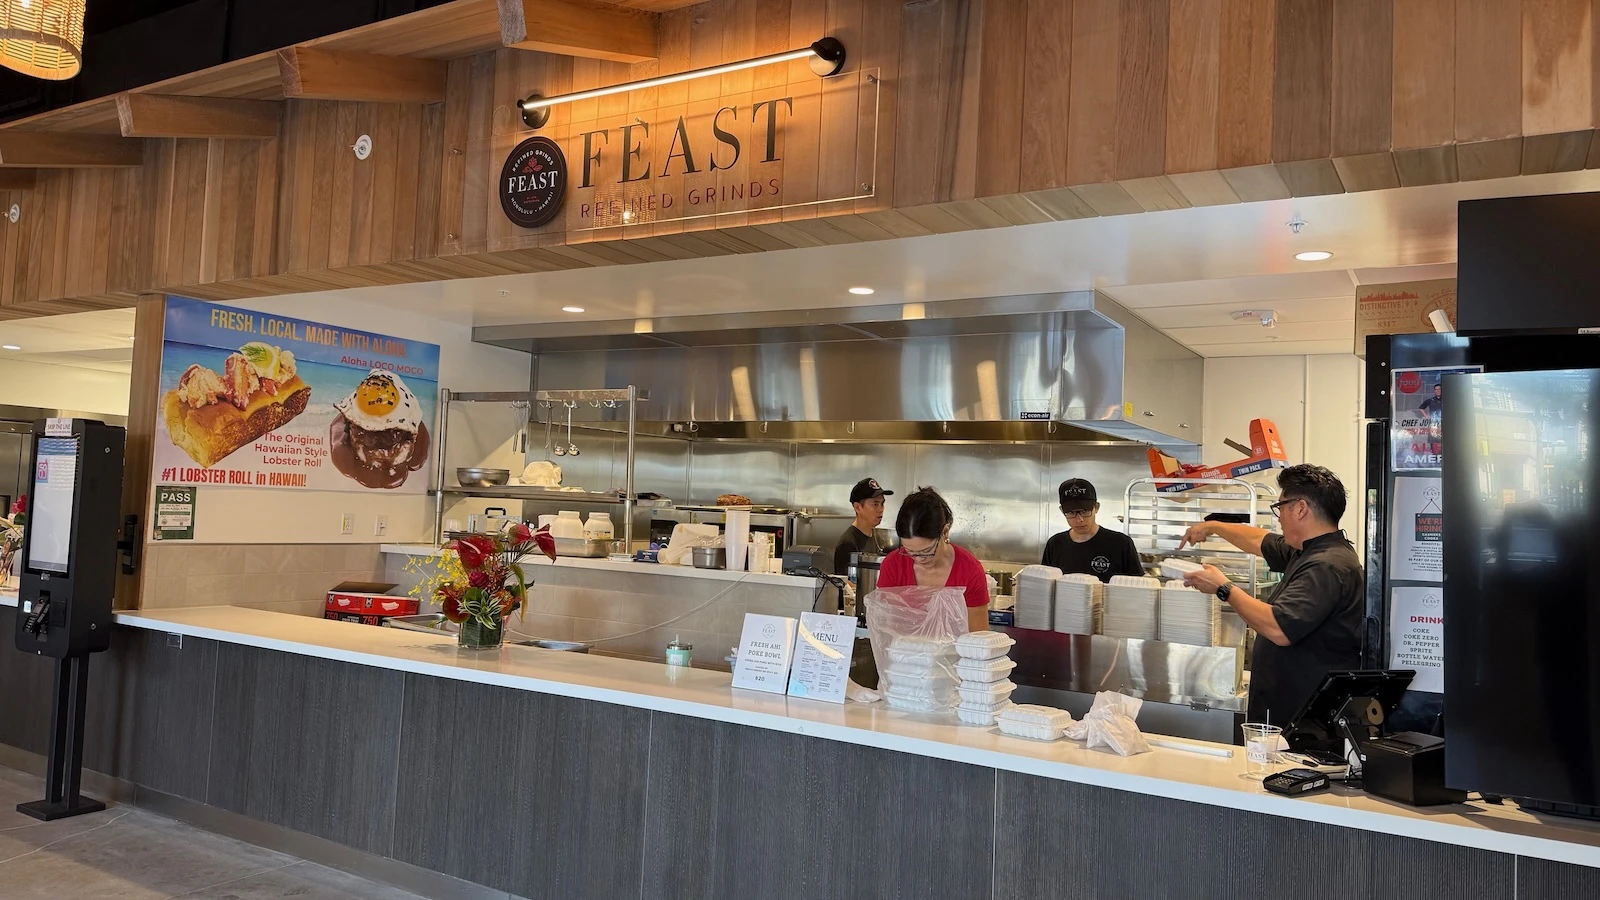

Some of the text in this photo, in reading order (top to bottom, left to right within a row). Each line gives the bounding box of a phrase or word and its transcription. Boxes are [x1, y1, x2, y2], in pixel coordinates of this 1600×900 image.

[578, 97, 792, 188] FEAST
[512, 149, 554, 172] REFINED GRINDS
[508, 170, 558, 194] FEAST
[581, 178, 779, 218] REFINED GRINDS
[511, 197, 533, 215] HONOLULU
[1360, 302, 1401, 311] DISTINCTIVE
[211, 308, 408, 358] FRESH. LOCAL. MADE WITH ALOHA.
[341, 356, 423, 376] Aloha LOCO MOCO
[1402, 419, 1419, 427] CHEF
[265, 433, 324, 446] The Original
[255, 444, 328, 458] Hawaiian Style
[264, 456, 322, 467] Lobster Roll
[1238, 467, 1250, 475] TWIN
[162, 468, 307, 487] #1 LOBSTER ROLL in HAWAII!
[161, 493, 191, 502] PASS
[1065, 488, 1086, 496] FEAST
[363, 615, 378, 626] 750
[1410, 616, 1444, 624] DRINK
[812, 632, 839, 643] MENU
[750, 641, 769, 649] FRESH
[1248, 751, 1265, 759] FEAST
